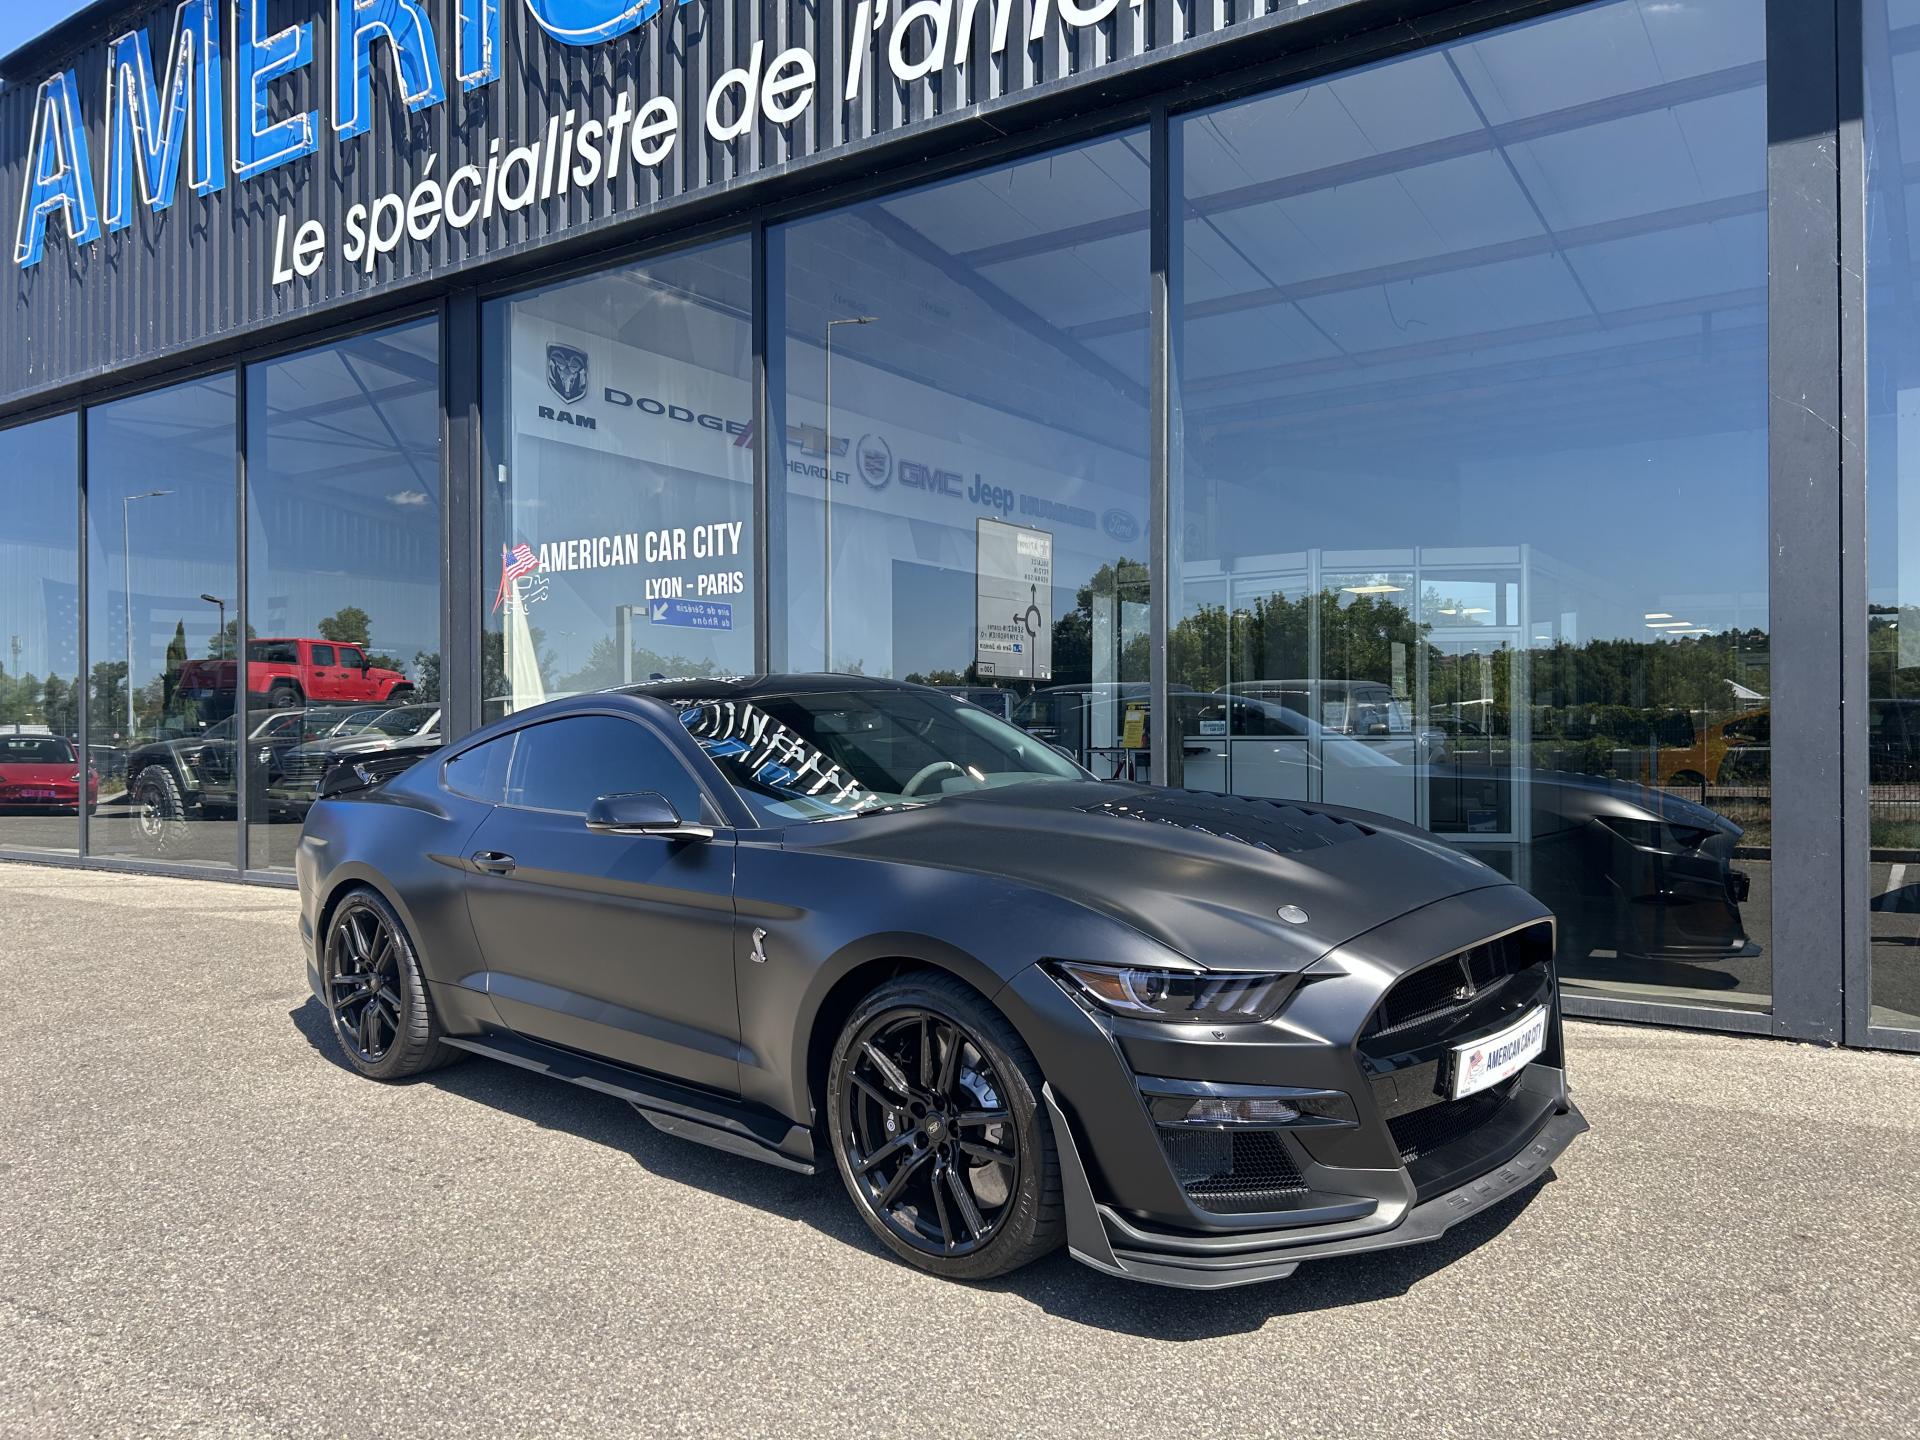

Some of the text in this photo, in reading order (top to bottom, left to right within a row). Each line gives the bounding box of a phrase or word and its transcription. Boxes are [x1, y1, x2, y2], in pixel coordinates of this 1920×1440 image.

[13, 0, 693, 268] AMER
[272, 0, 1144, 285] Le spécialiste de l'am
[538, 405, 597, 430] RAM
[604, 387, 751, 435] DODGE
[785, 460, 850, 485] HEVROLET
[898, 460, 963, 498] GMC
[968, 473, 1015, 517] Jeep
[538, 521, 743, 573] AMERICAN CAR CITY
[1106, 511, 1136, 540] Ford
[645, 576, 683, 600] LYON
[697, 571, 744, 596] PARIS
[1486, 1038, 1521, 1072] AMERICAN
[1521, 1029, 1532, 1053] CAR
